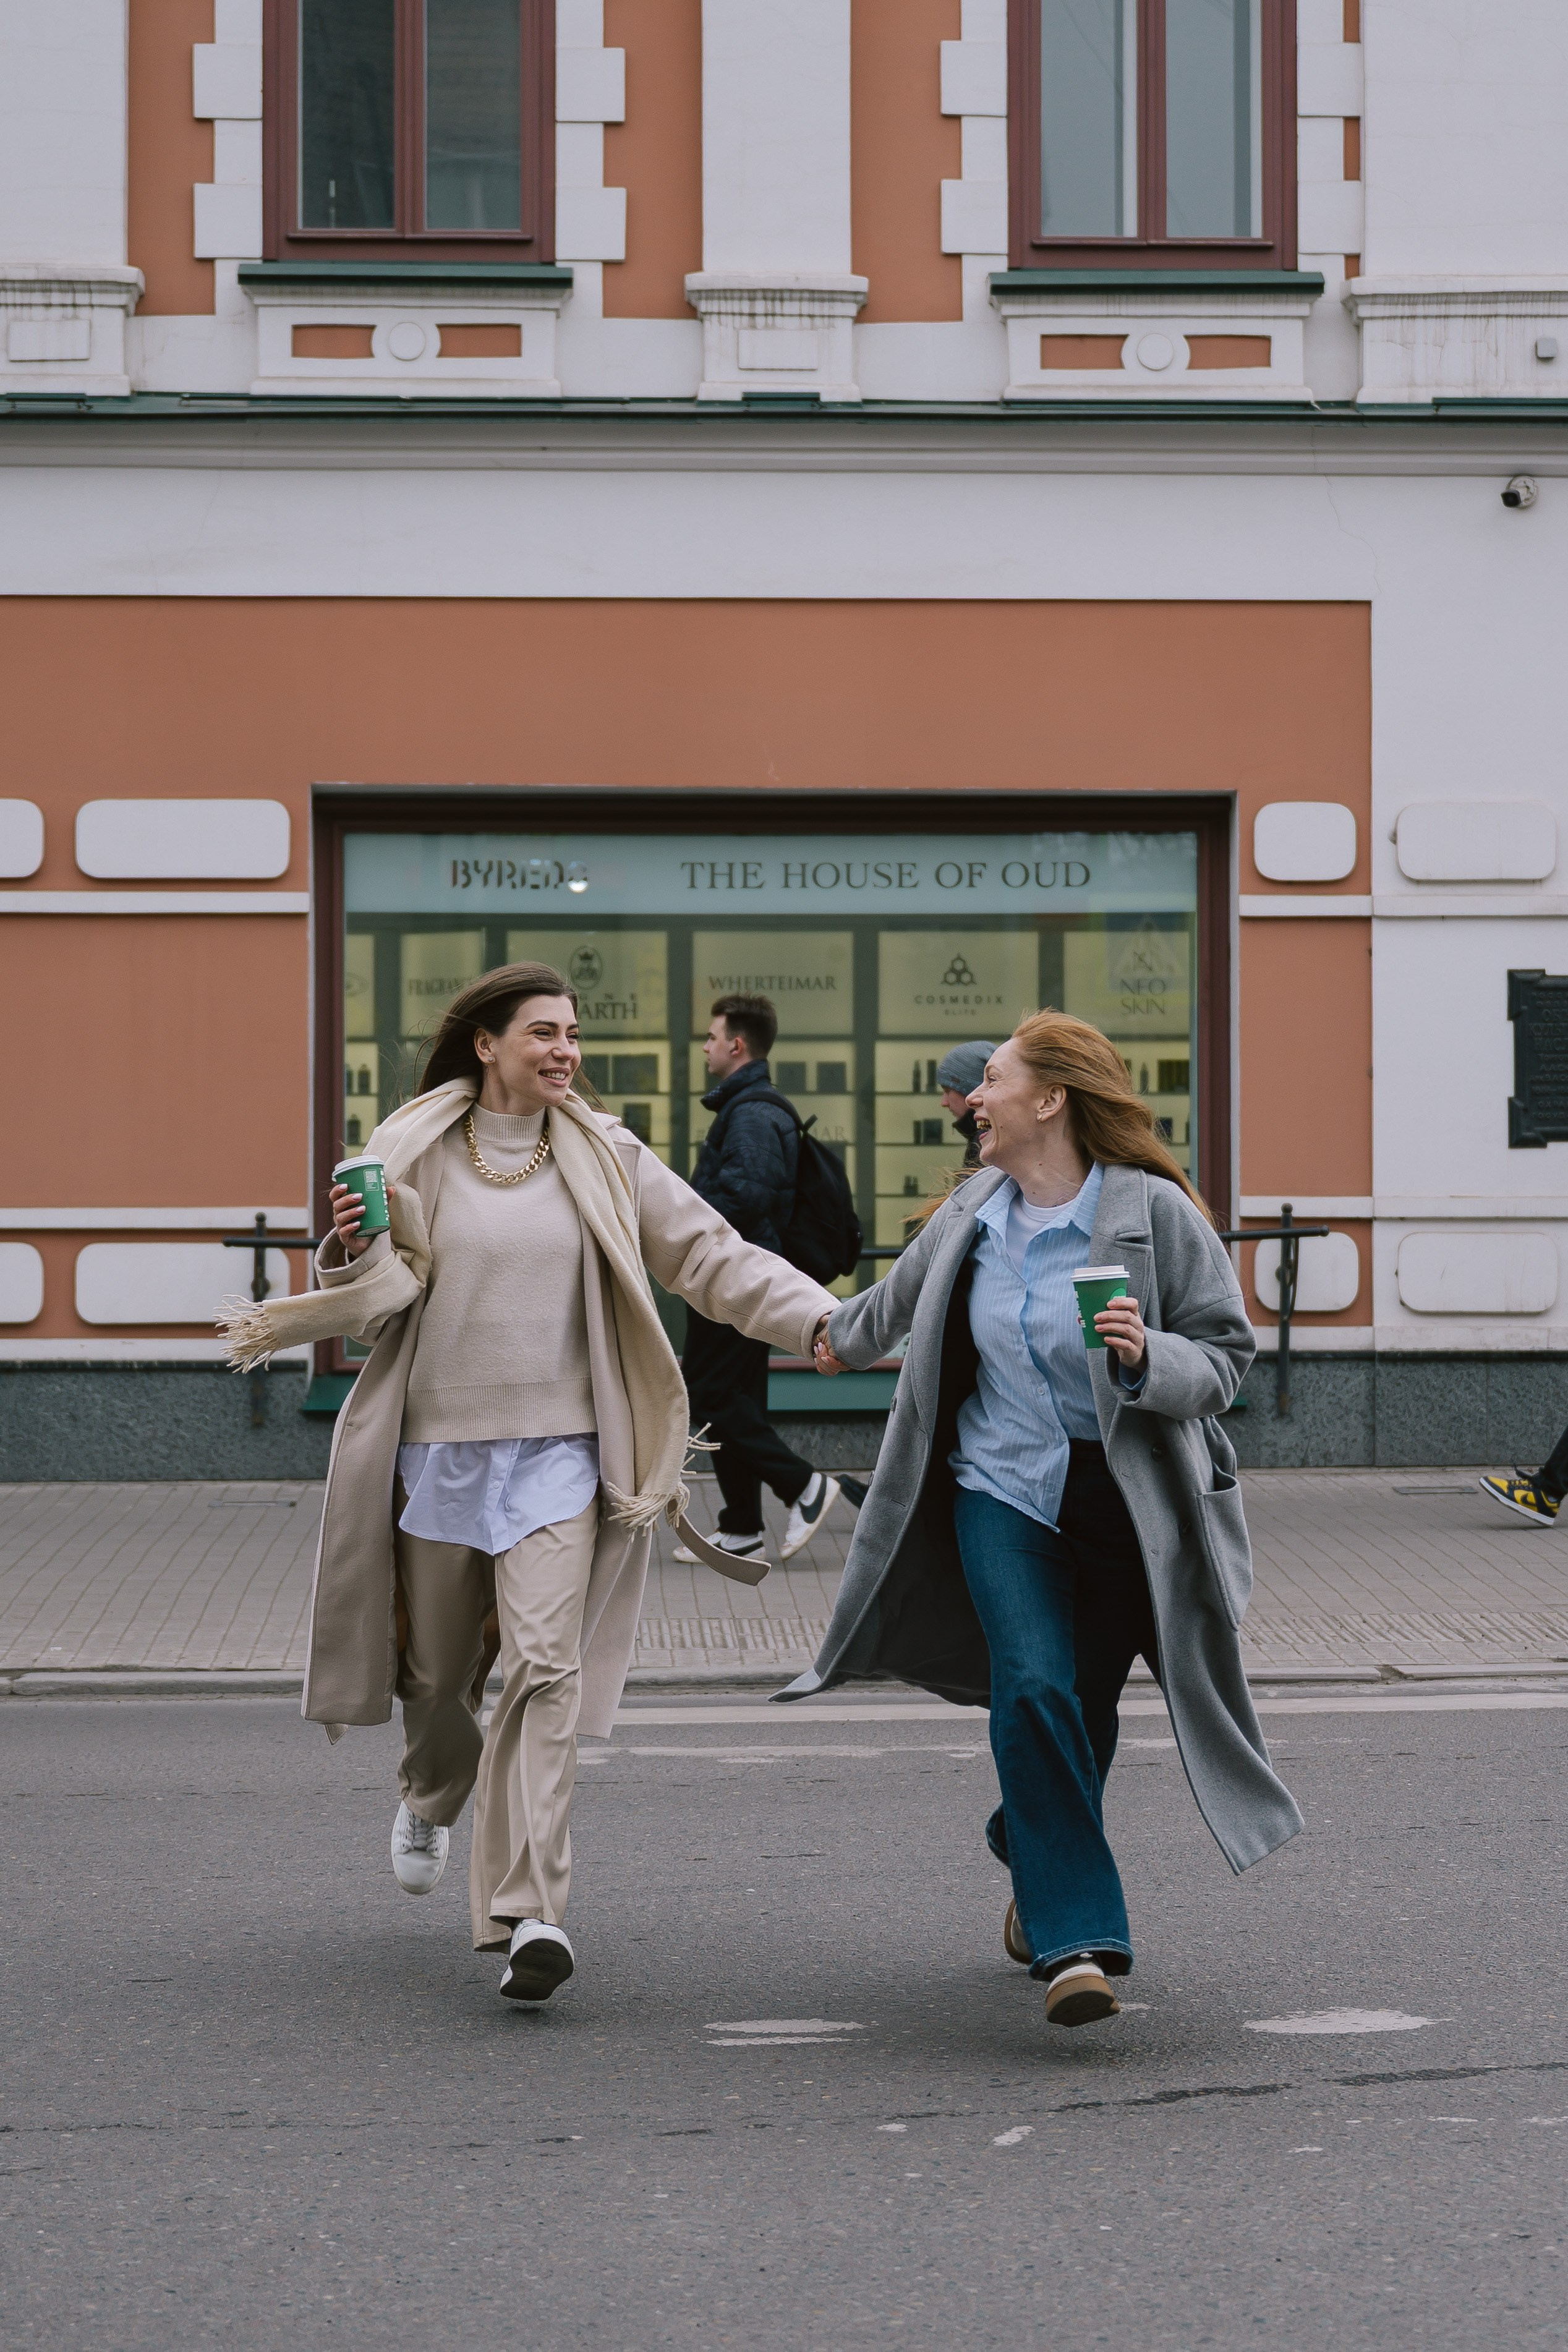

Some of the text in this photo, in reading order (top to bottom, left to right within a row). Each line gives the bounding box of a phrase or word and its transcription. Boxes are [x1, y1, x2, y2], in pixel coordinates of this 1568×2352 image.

[452, 860, 587, 892] BYRED
[681, 861, 1090, 889] THE HOUSE OF OUD
[709, 976, 837, 990] WHERTEIMAR
[914, 995, 1003, 1004] COSMEDIX
[1121, 998, 1165, 1014] SKIN
[577, 1002, 637, 1019] ARTH
